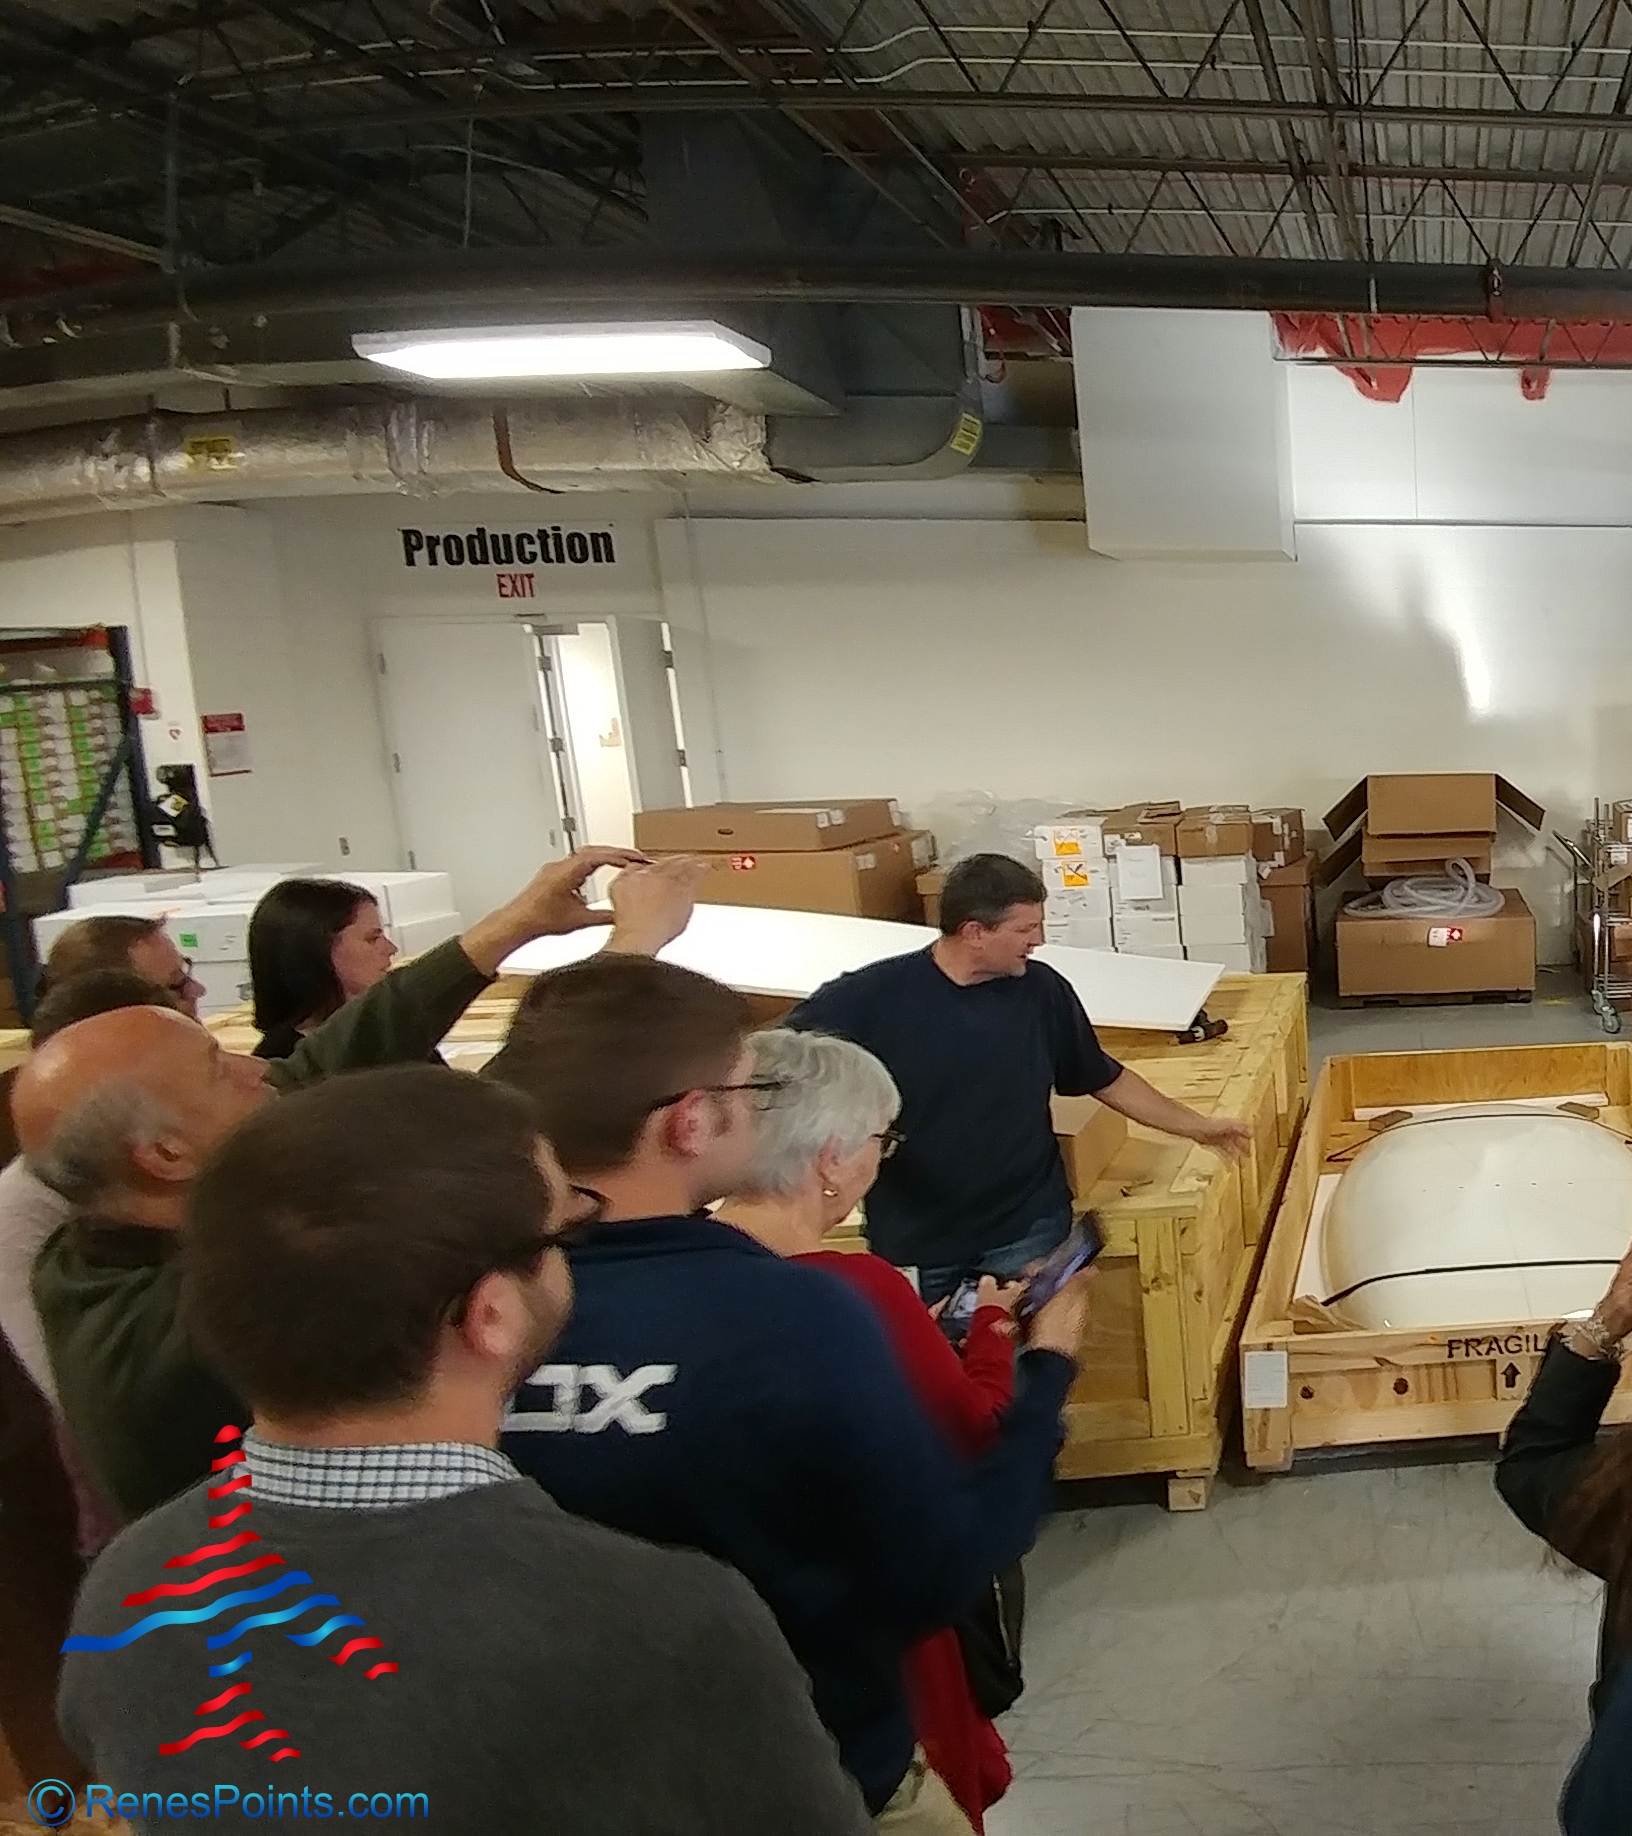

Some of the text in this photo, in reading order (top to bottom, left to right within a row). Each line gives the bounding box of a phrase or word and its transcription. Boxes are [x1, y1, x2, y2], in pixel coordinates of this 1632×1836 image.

[401, 526, 616, 567] Production
[496, 573, 535, 598] EXIT
[1447, 1333, 1547, 1359] FRAGIL
